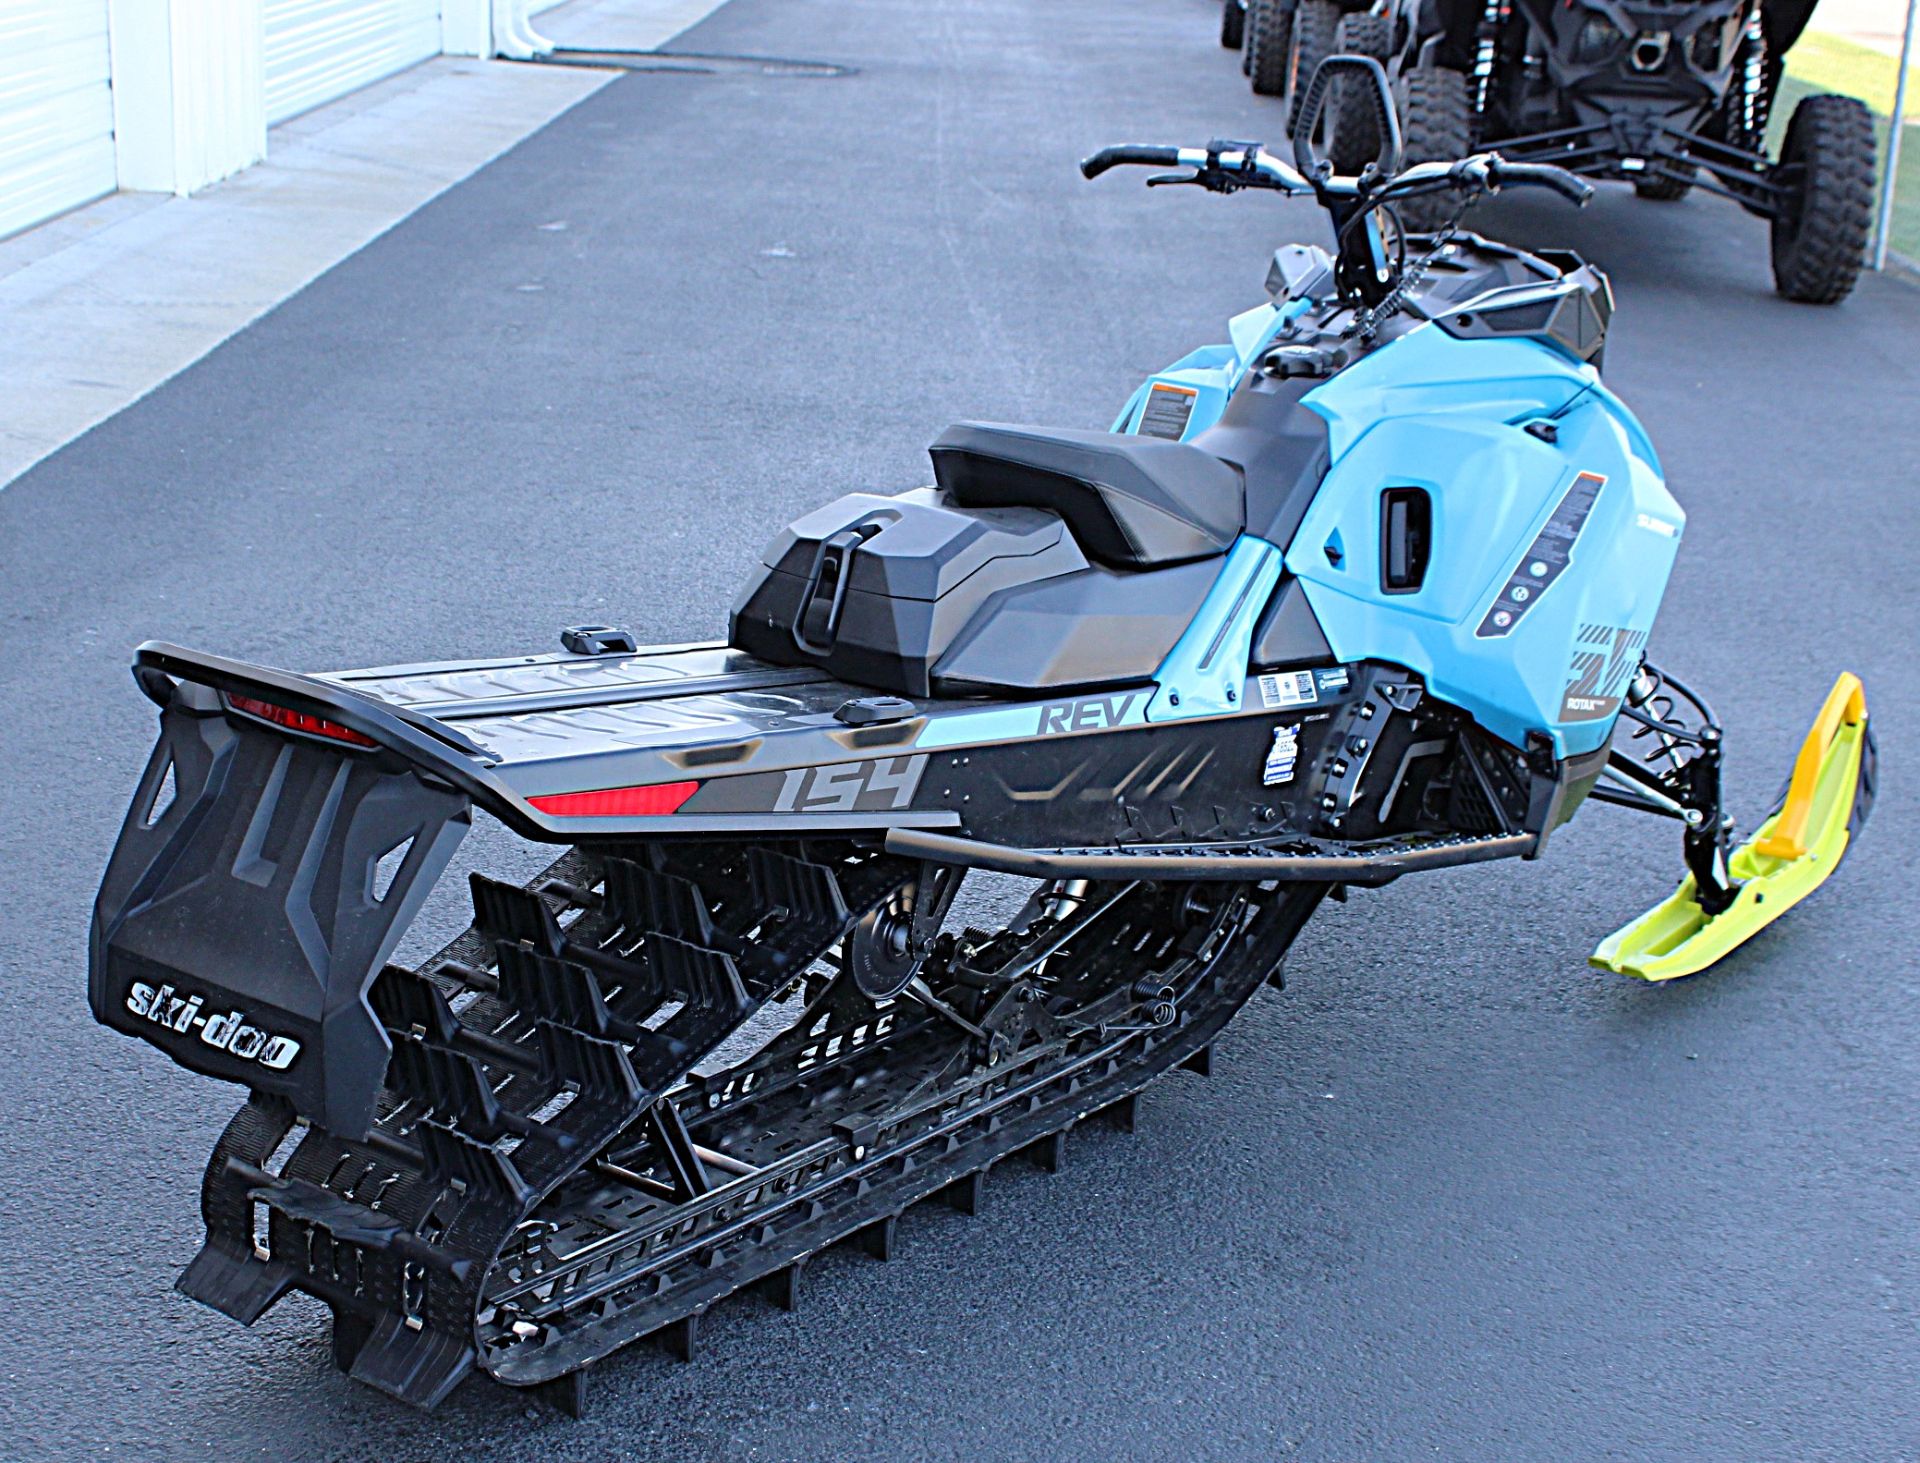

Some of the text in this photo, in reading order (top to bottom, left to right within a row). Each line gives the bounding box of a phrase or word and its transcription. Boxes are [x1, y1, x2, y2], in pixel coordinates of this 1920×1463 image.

[1037, 694, 1136, 735] REV
[1567, 697, 1595, 711] ROTAX
[773, 753, 930, 812] 154
[127, 982, 301, 1070] ski-doo
